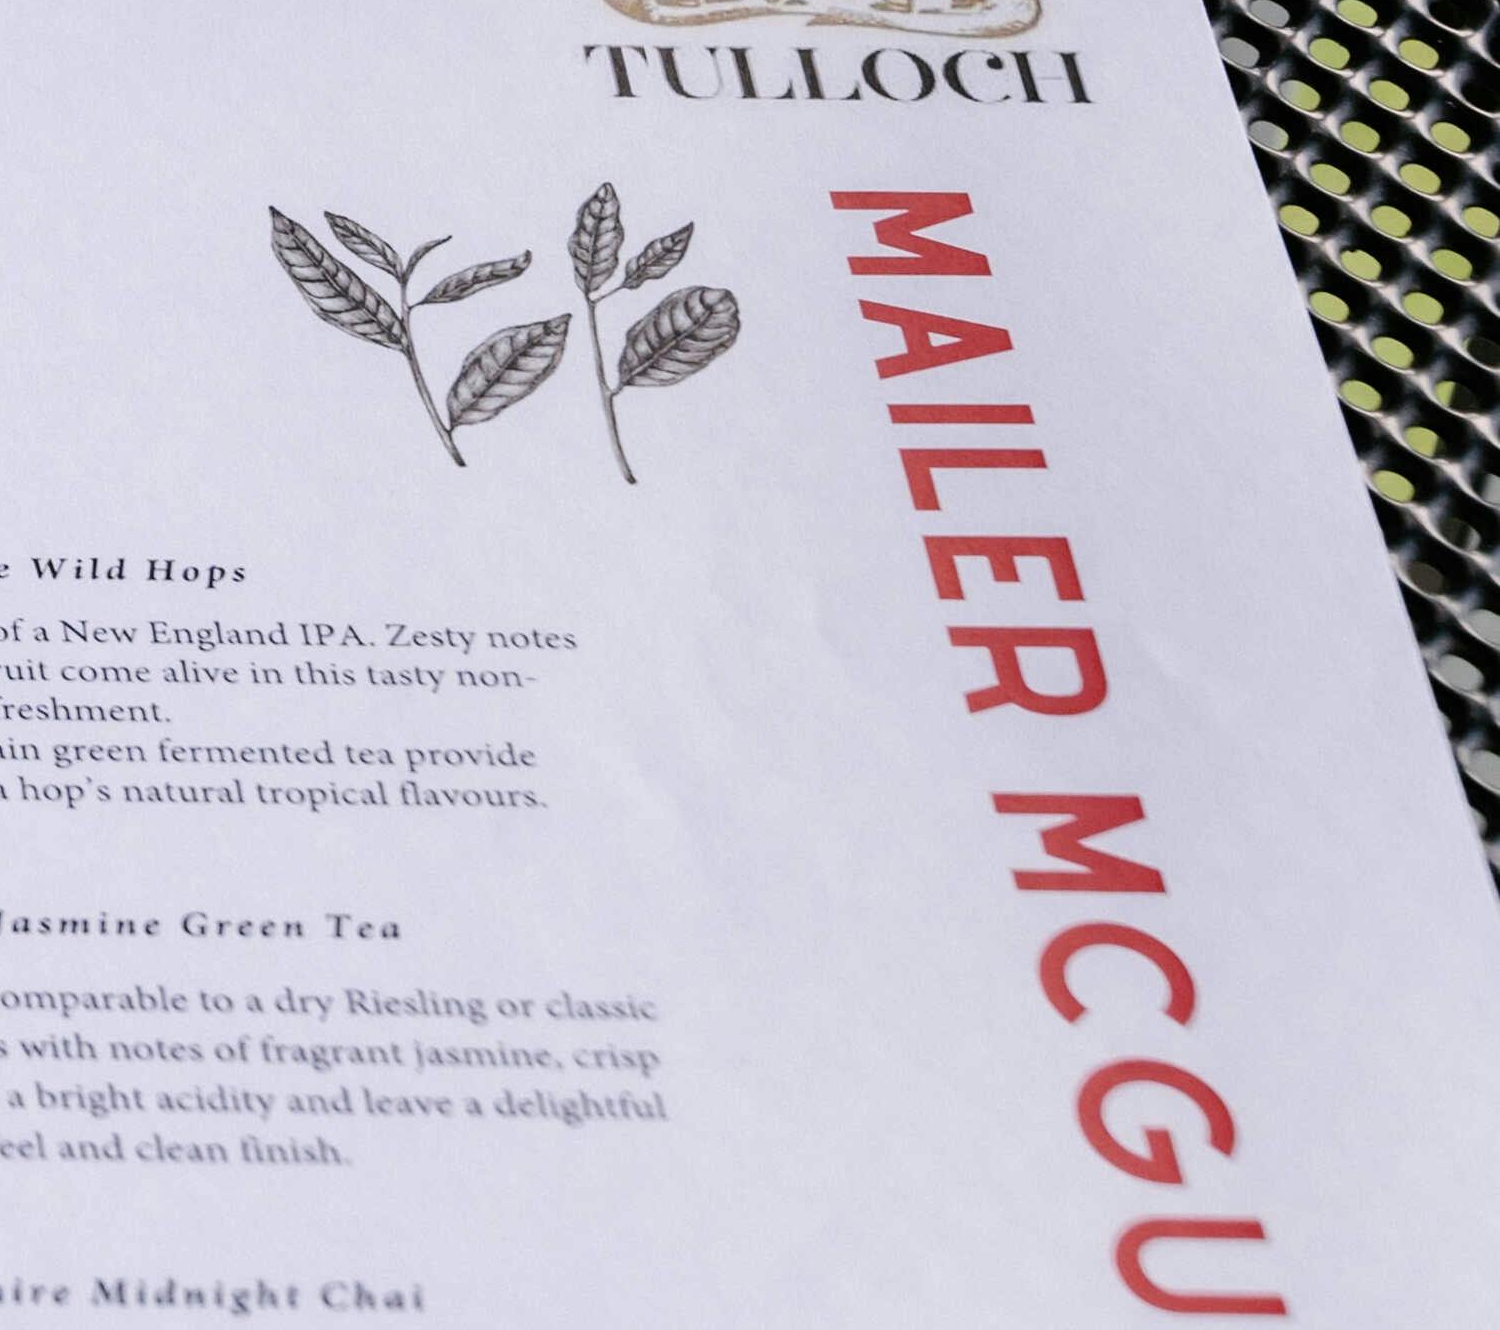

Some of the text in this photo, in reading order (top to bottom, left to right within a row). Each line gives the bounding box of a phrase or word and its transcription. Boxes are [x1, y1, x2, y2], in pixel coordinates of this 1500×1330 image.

[581, 42, 1098, 106] TULLOCH
[827, 188, 1111, 718] MAILER
[29, 555, 127, 582] Wild
[145, 557, 247, 591] Hops
[32, 625, 52, 644] a
[58, 618, 139, 645] New
[147, 619, 291, 654] England
[298, 621, 376, 648] IPA.
[384, 622, 476, 656] Zesty
[486, 628, 579, 651] notes
[59, 664, 152, 685] come
[162, 657, 240, 685] alive
[249, 667, 285, 686] in
[293, 659, 358, 687] this
[365, 665, 446, 695] tasty
[455, 669, 538, 689] non-
[51, 743, 148, 770] green
[157, 736, 336, 766] fermented
[343, 744, 396, 767] tea
[404, 740, 536, 775] provide
[121, 777, 247, 805] natural
[254, 779, 390, 814] tropical
[398, 779, 549, 809] flavours.
[178, 910, 306, 940] Green
[323, 911, 403, 942] Tea
[89, 1276, 301, 1319] Midnight
[317, 1279, 426, 1314] Chai
